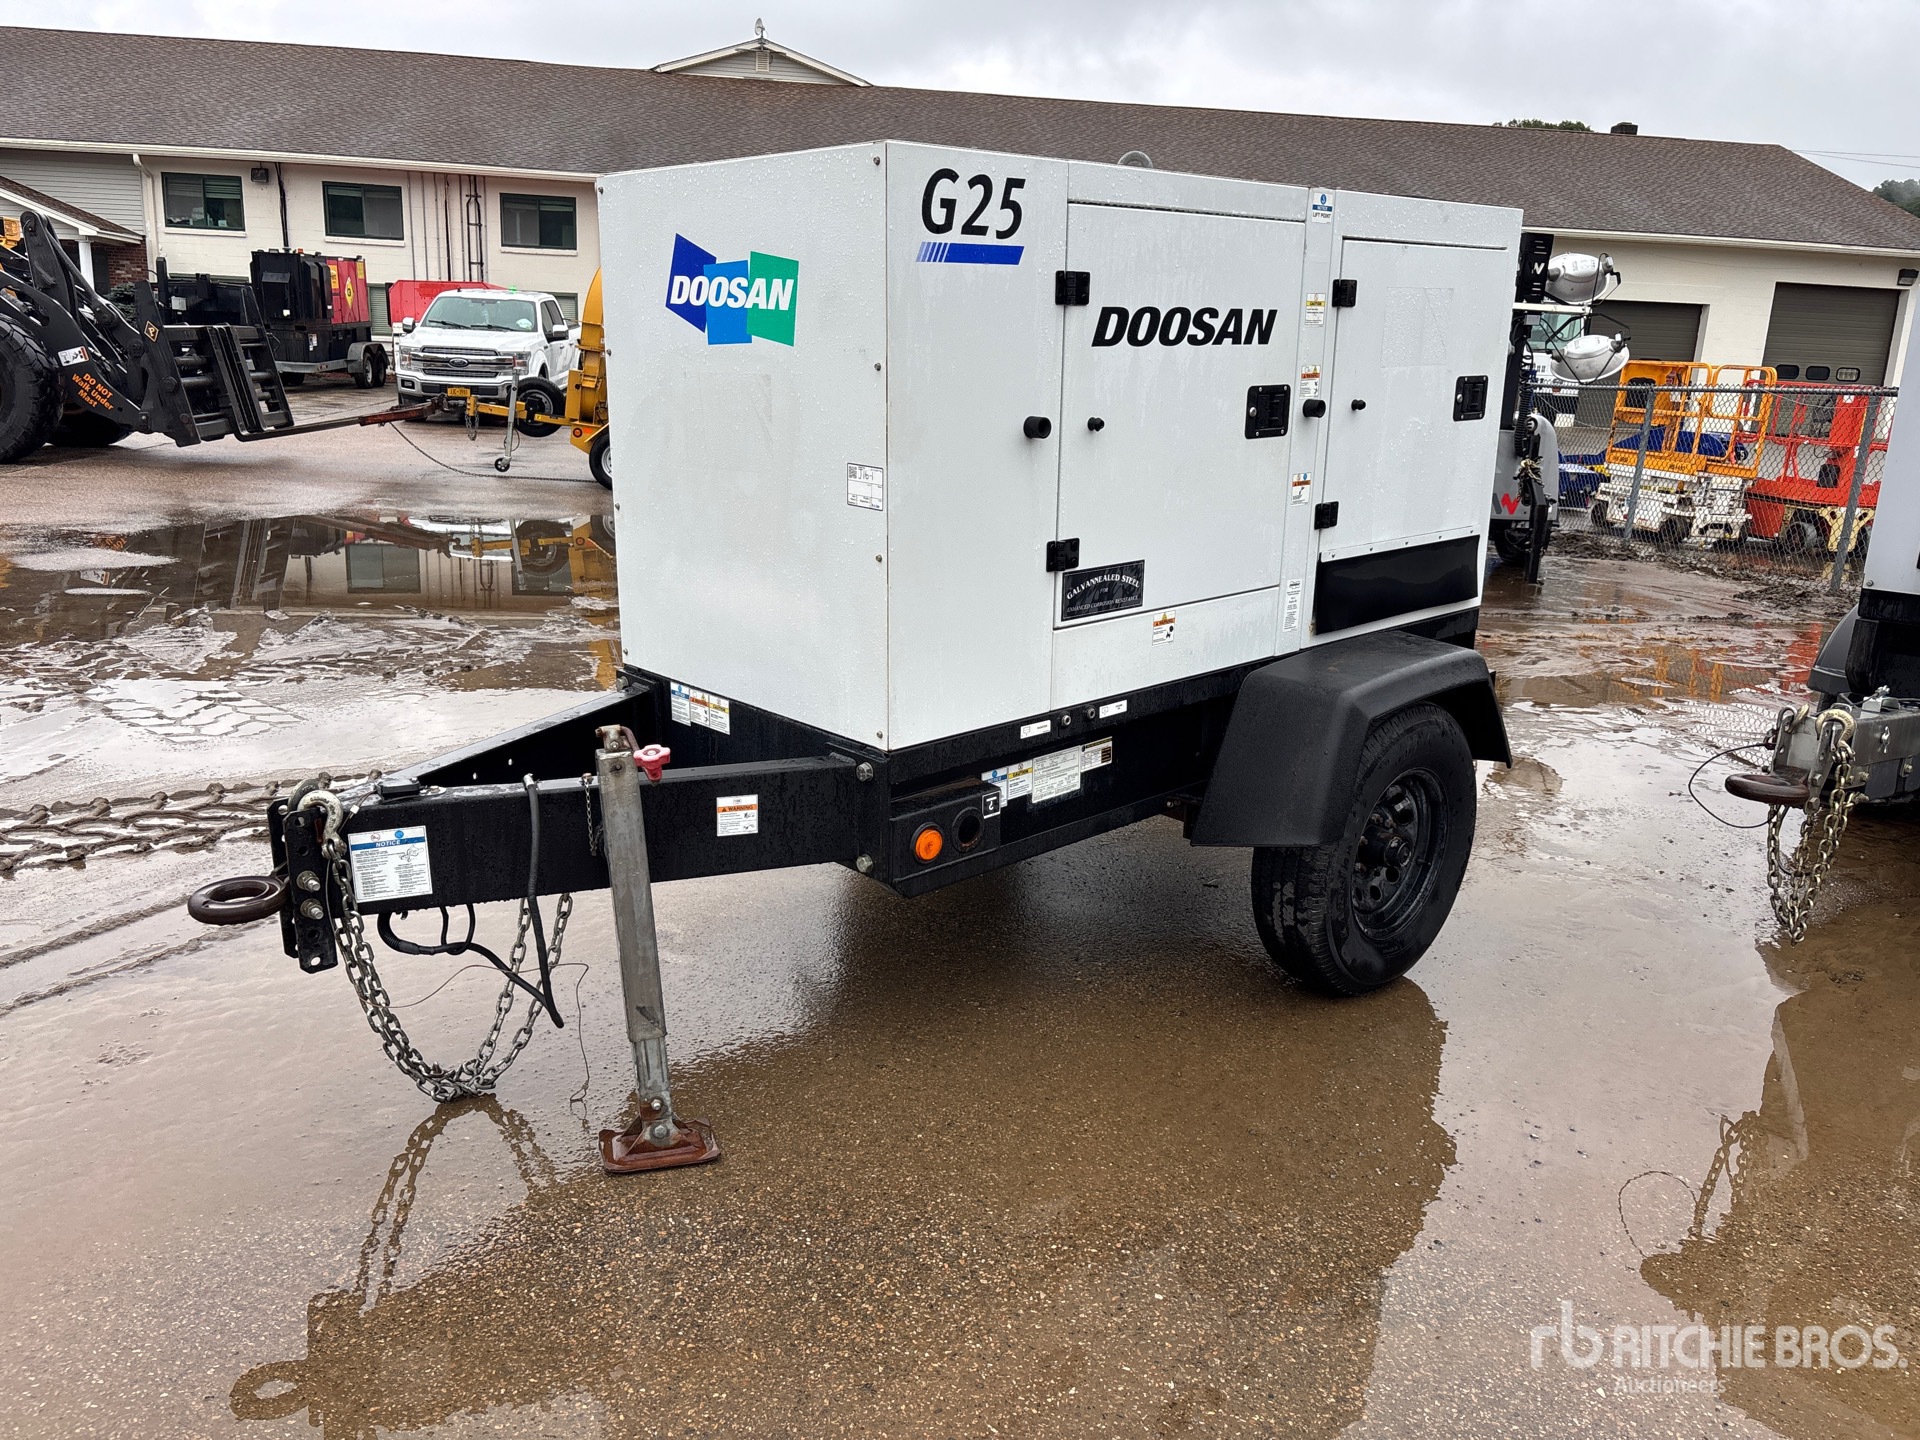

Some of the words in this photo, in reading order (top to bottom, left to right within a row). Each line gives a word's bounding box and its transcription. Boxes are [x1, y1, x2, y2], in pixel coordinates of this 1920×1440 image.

[921, 168, 1026, 240] G25
[670, 275, 796, 312] DOOSAN
[1091, 306, 1278, 347] DOOSAN
[72, 374, 91, 392] Walk
[91, 389, 114, 410] Under
[78, 389, 98, 407] Mast
[83, 373, 97, 386] DO
[96, 383, 113, 399] NOT
[1066, 574, 1121, 600] GALVANNEALED
[1121, 575, 1140, 588] STEEL
[1066, 603, 1091, 612] ENHANCED
[1114, 595, 1139, 604] RESISTANCE
[728, 804, 754, 812] WARNING
[375, 840, 401, 848] NOTICE
